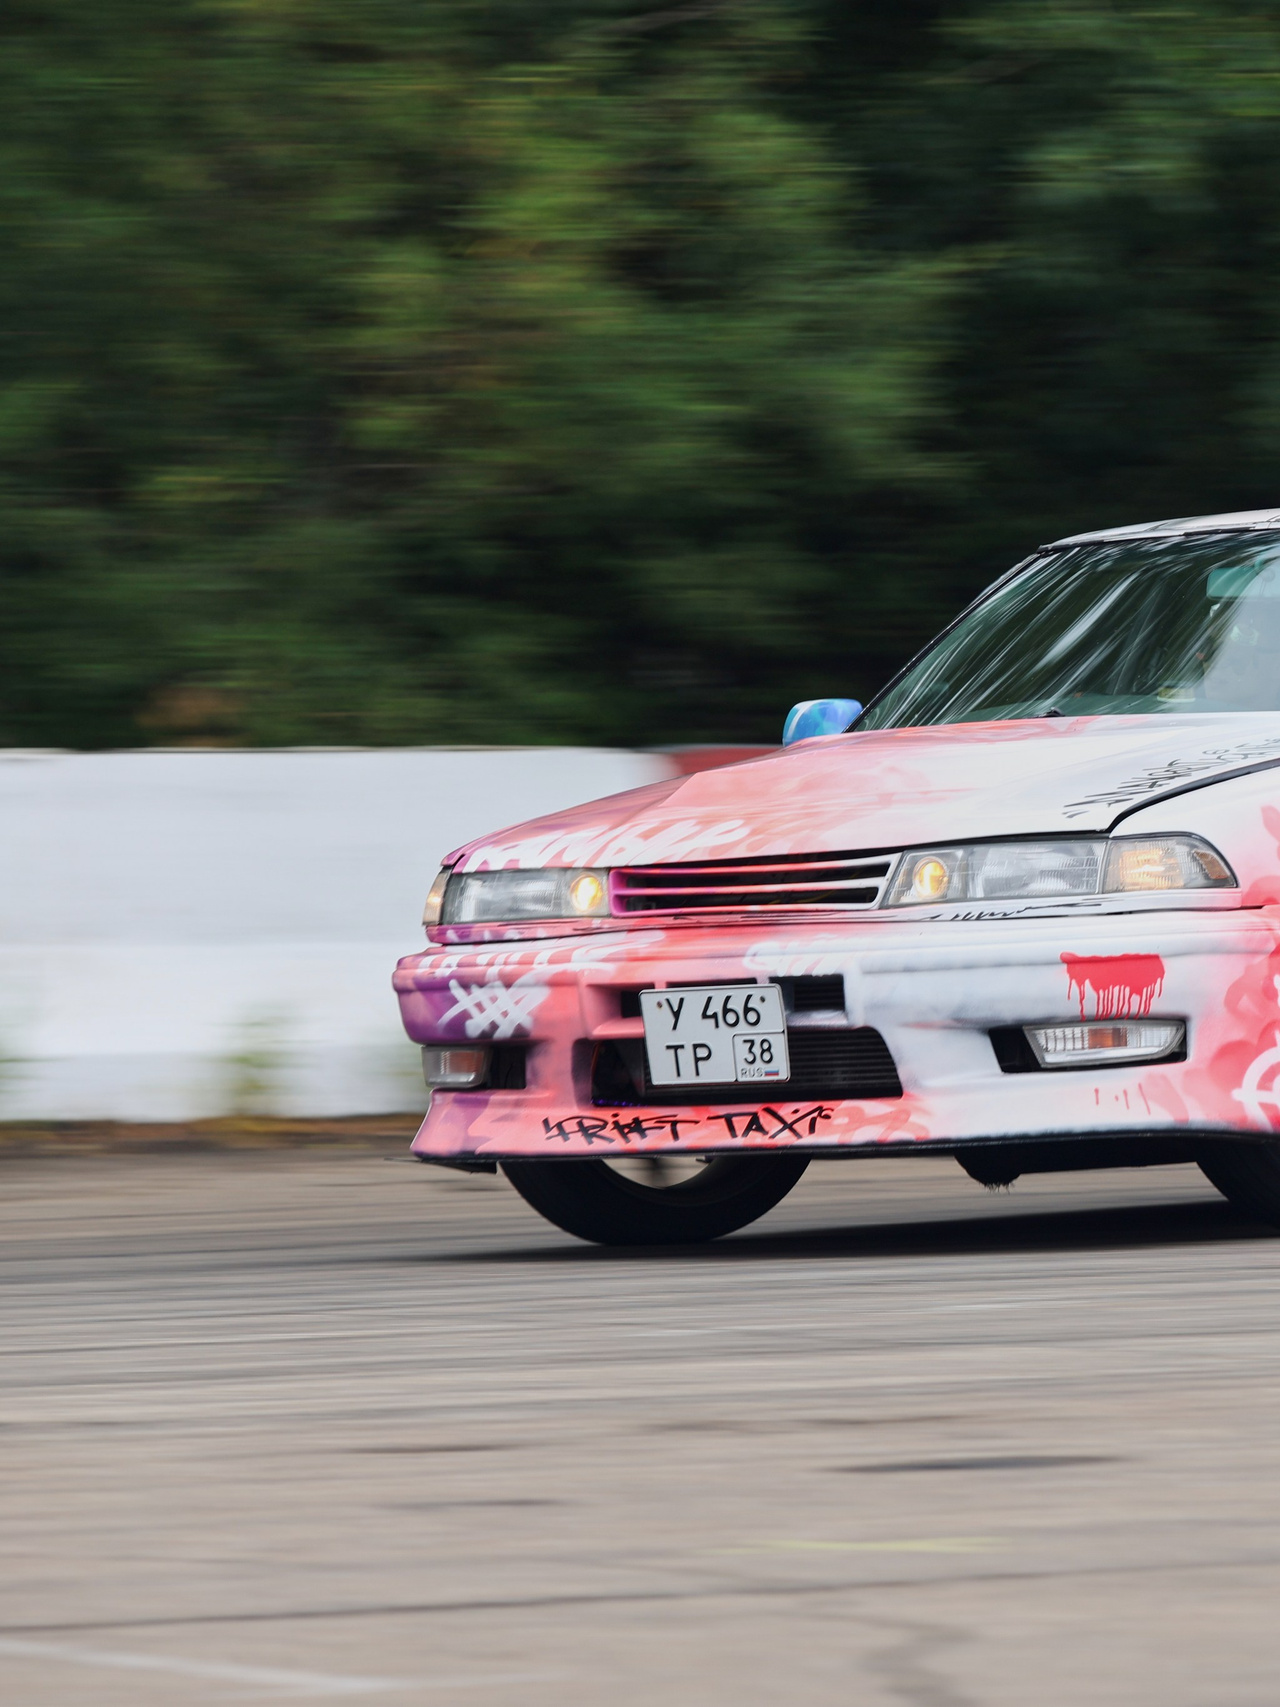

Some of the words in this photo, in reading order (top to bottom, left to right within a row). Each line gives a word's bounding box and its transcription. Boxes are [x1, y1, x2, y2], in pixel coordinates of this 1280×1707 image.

[701, 994, 761, 1029] 466
[743, 1038, 774, 1065] 38
[740, 1068, 764, 1078] RUS
